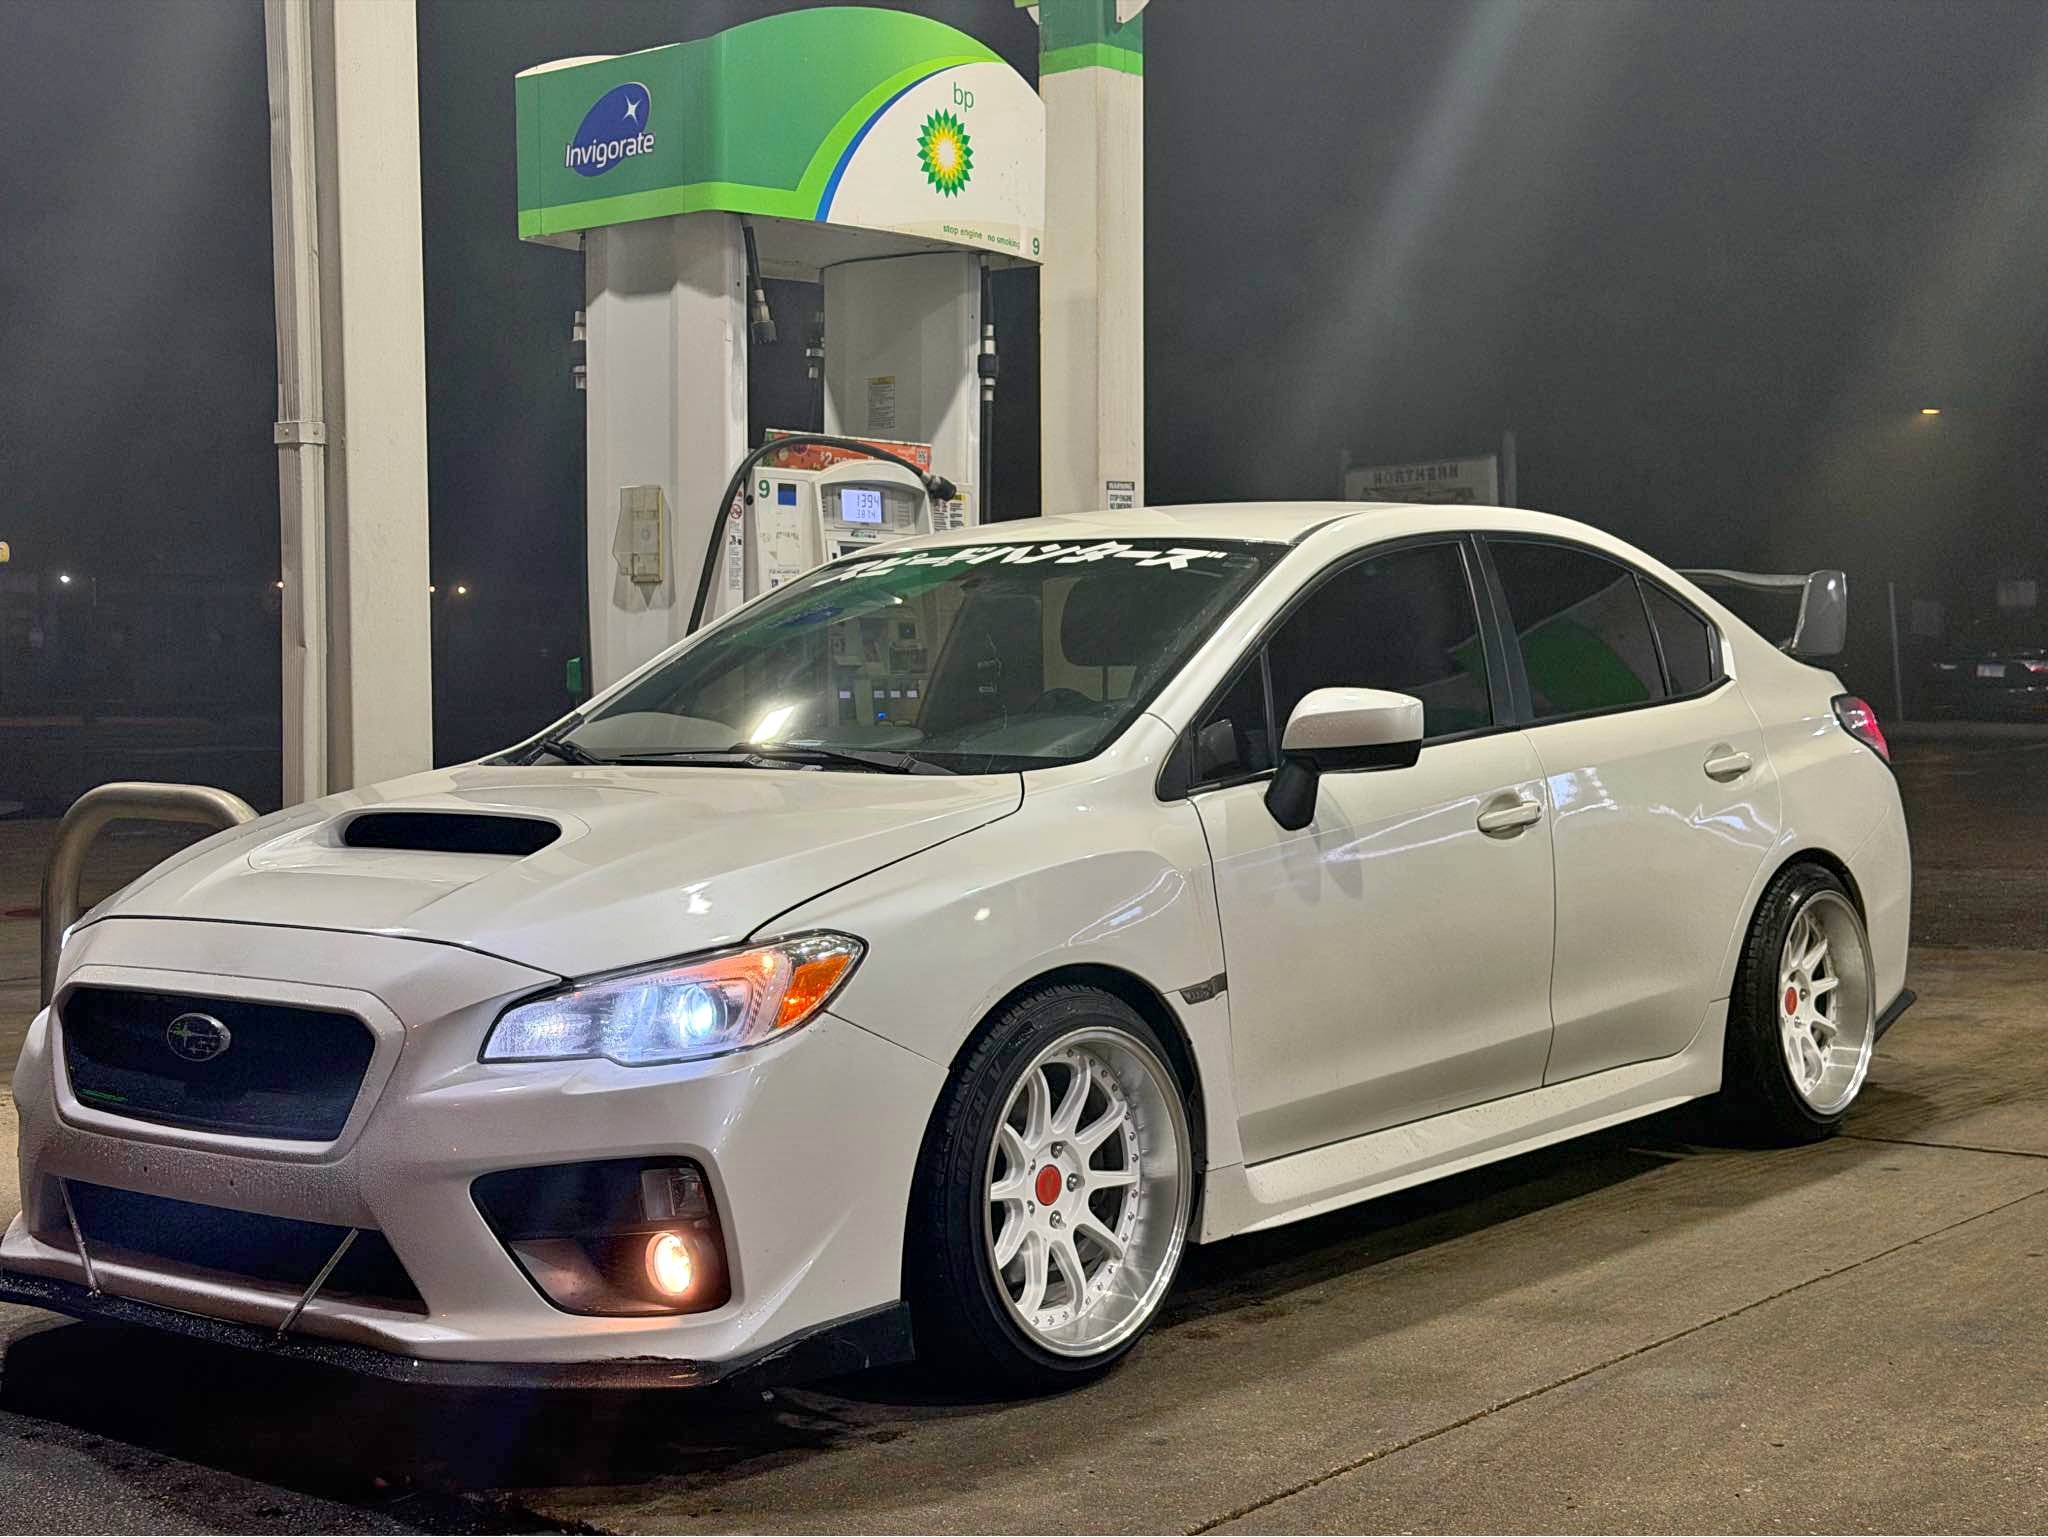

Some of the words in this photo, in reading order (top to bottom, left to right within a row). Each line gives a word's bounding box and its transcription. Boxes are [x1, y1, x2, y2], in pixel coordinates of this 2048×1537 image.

[953, 80, 974, 113] bp
[565, 132, 655, 169] Invigorate
[943, 224, 959, 236] stop
[960, 228, 983, 241] engine
[987, 234, 996, 243] no
[1032, 237, 1041, 256] 9
[758, 479, 771, 499] 9
